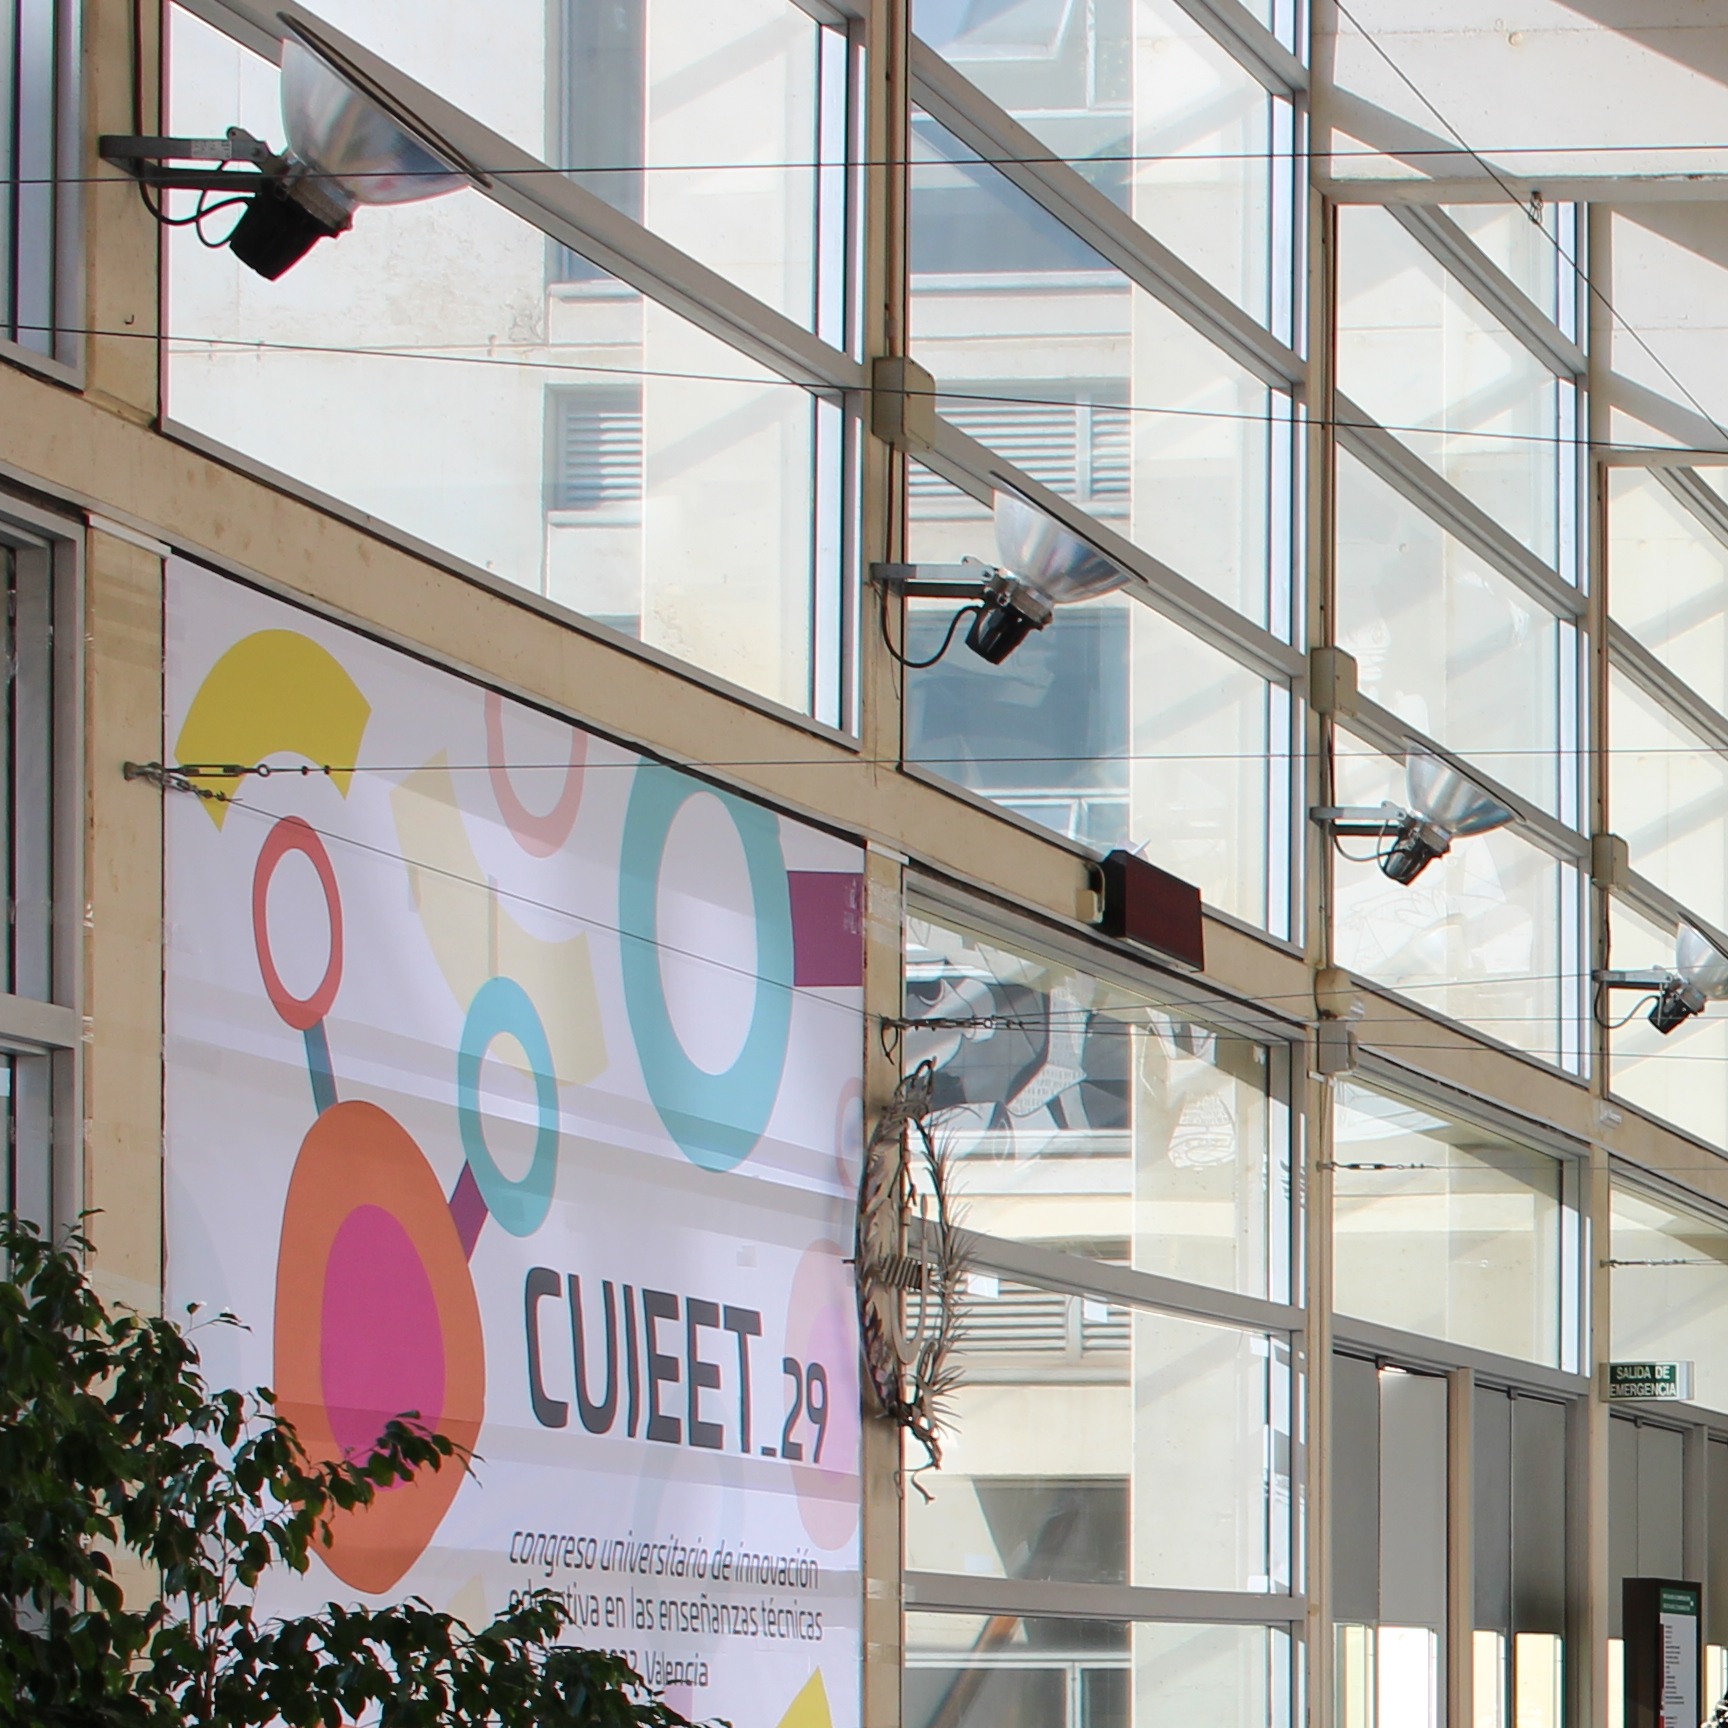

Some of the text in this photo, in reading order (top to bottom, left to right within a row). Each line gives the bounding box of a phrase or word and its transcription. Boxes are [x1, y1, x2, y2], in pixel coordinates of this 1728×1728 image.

[524, 1266, 829, 1464] CUIEET_29
[1616, 1366, 1671, 1380] SALIDA DE
[1610, 1382, 1677, 1396] EMERGENCIA
[509, 1530, 819, 1590] congreso universitario de innovación
[605, 1596, 626, 1629] en
[631, 1586, 655, 1630] las
[659, 1594, 759, 1637] enseñanzas
[762, 1597, 824, 1642] técnicas
[645, 1650, 709, 1687] Valencia
